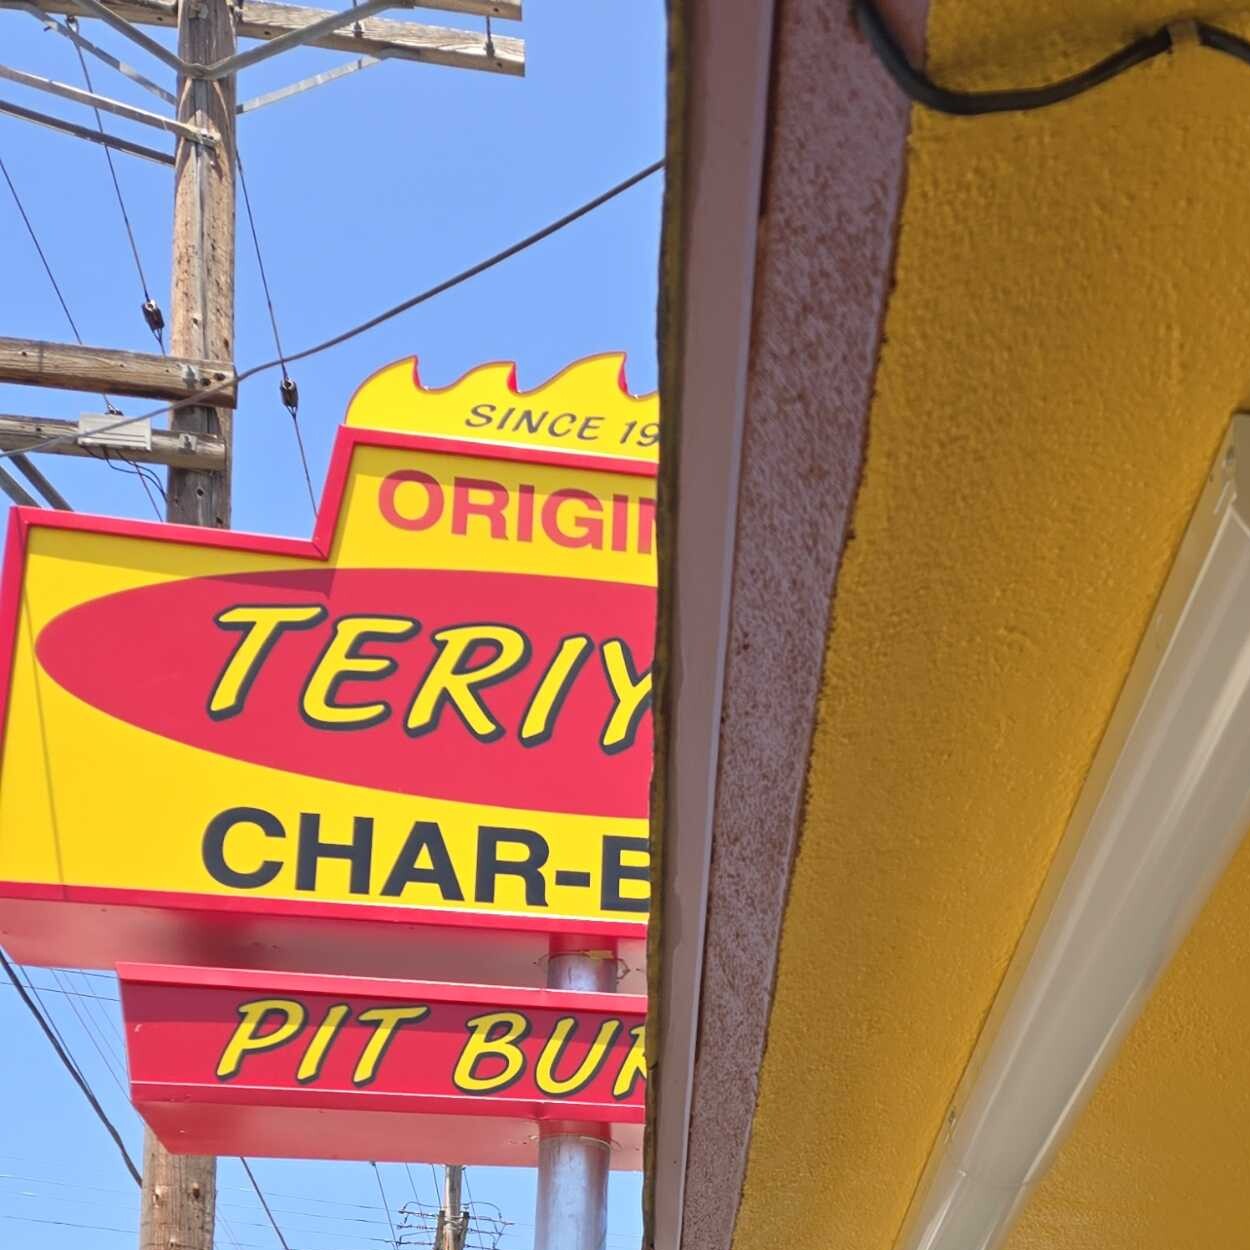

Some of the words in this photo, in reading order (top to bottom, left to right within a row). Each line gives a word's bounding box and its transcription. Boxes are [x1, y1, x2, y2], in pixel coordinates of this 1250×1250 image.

[465, 403, 605, 441] SINCE
[201, 806, 651, 914] CHAR-B
[214, 998, 430, 1088] PIT
